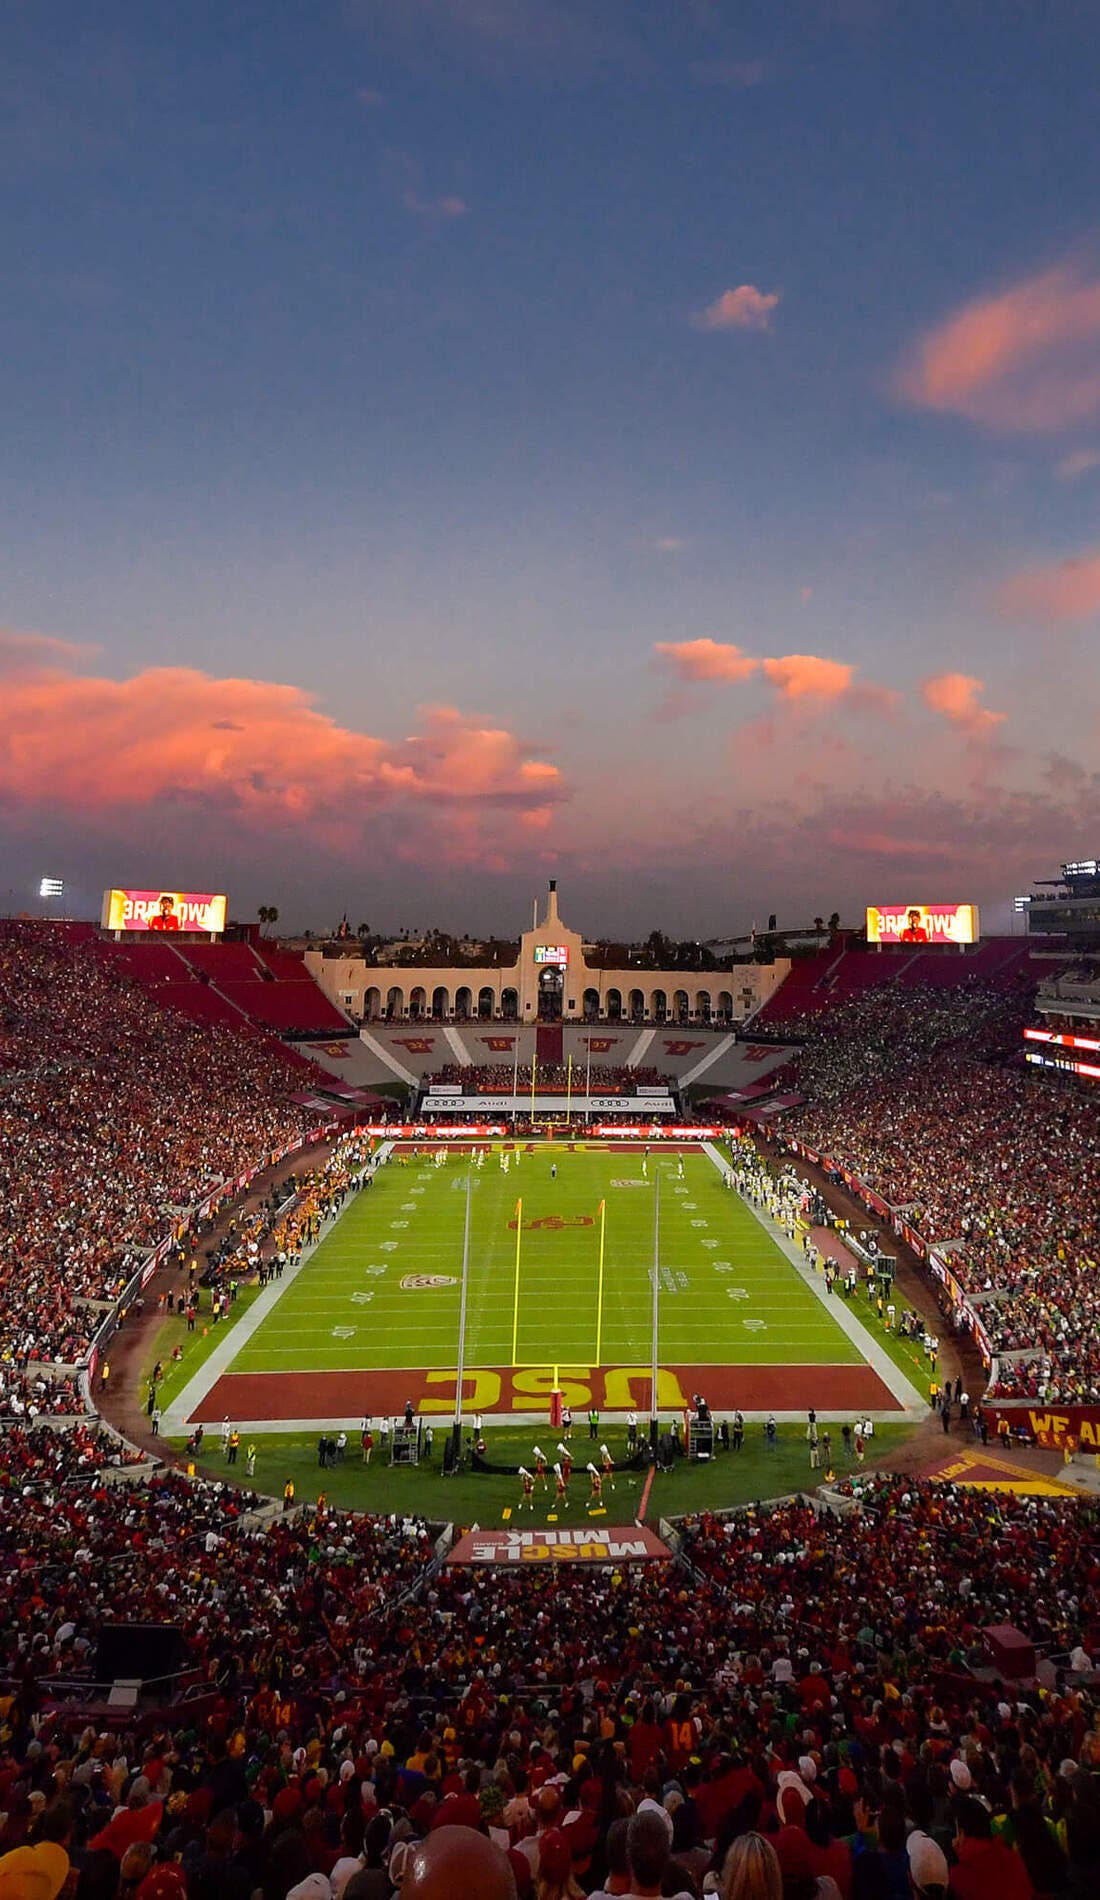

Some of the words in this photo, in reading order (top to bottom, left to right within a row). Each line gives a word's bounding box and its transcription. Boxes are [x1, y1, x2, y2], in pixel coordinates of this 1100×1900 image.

[418, 1367, 688, 1412] USC
[506, 1529, 611, 1546] MILK
[470, 1541, 648, 1560] MUSCLE
[274, 1704, 291, 1725] 14
[671, 1722, 693, 1750] 14
